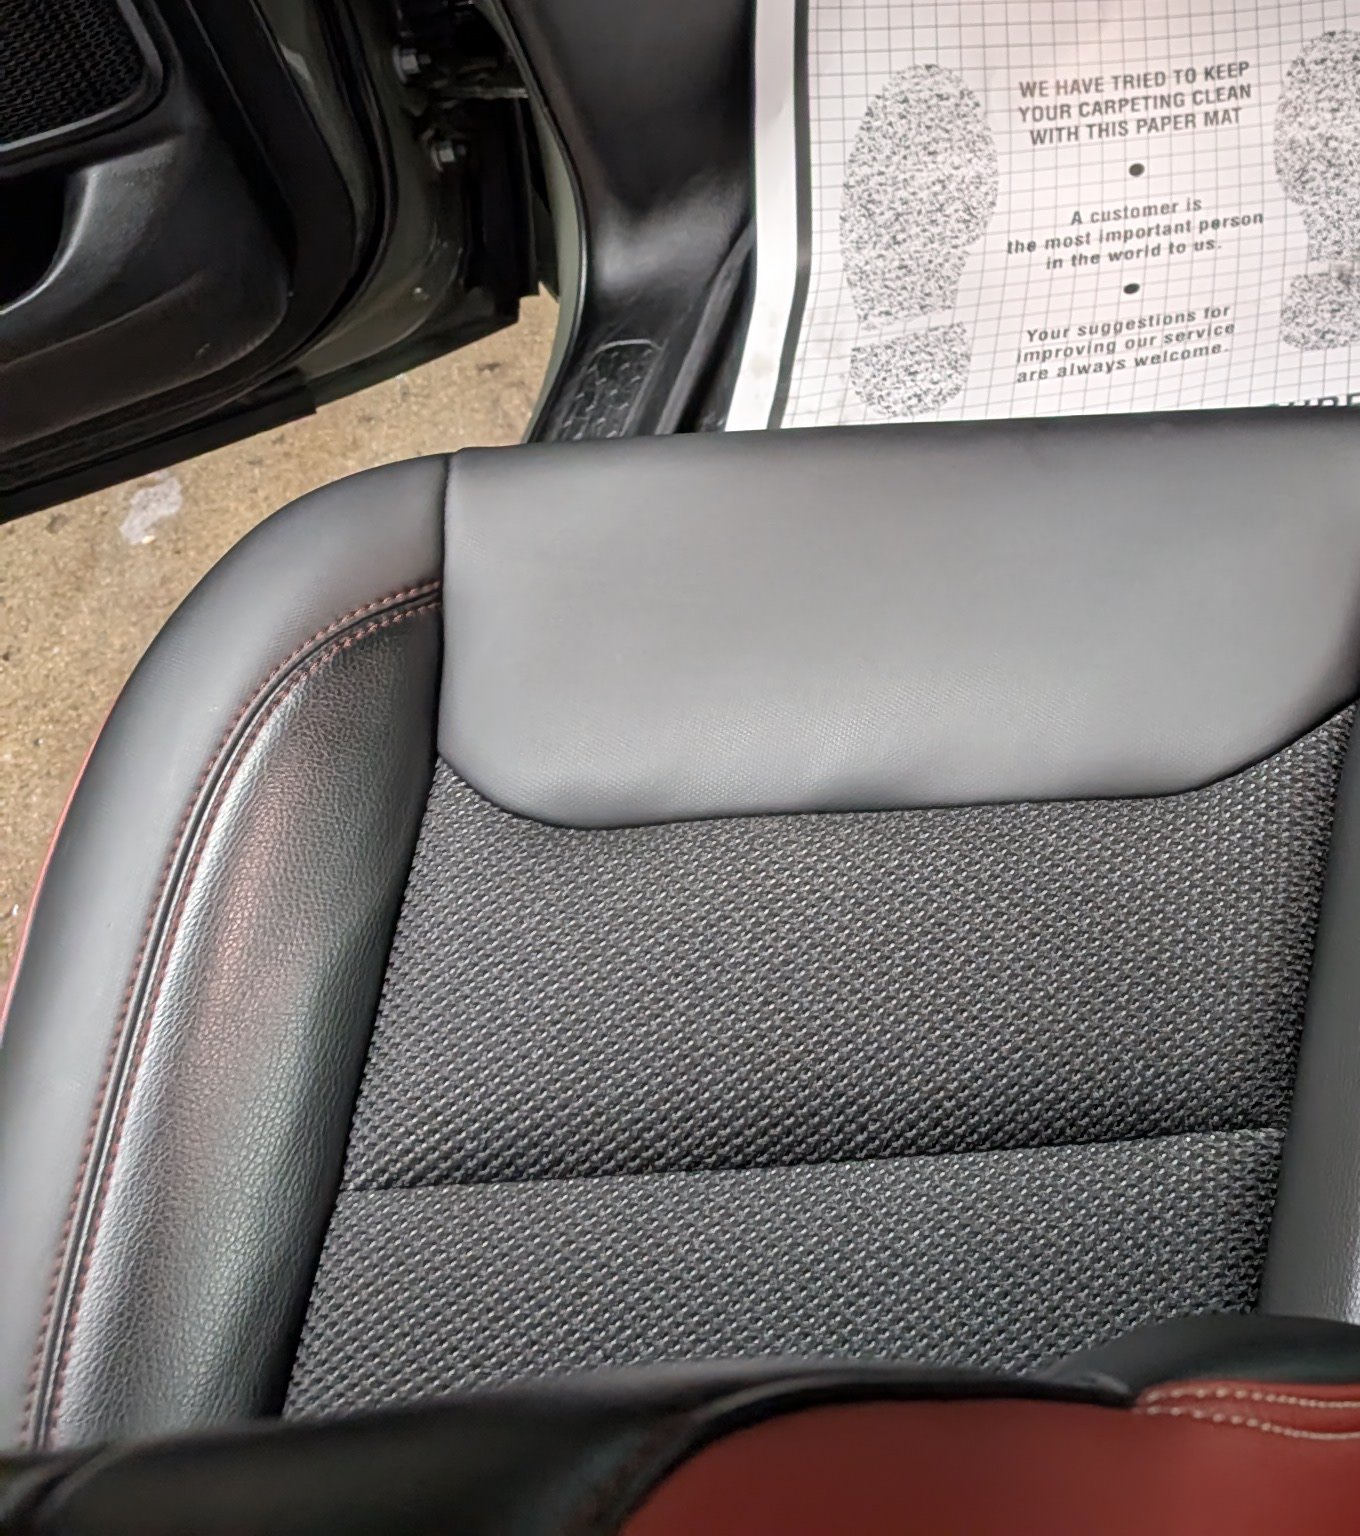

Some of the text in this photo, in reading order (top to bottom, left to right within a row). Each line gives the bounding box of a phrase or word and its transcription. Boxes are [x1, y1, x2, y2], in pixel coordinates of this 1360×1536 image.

[1019, 60, 1250, 99] WE HAVE TRIED TO KEEP
[1018, 82, 1252, 123] YOUR CARPETING CLEAN
[1030, 107, 1243, 146] WITH THIS PAPER MAT
[1070, 197, 1203, 226] A customer is
[1006, 212, 1265, 255] the most important person
[1046, 237, 1223, 270] in the world to us.
[1016, 321, 1236, 364] improving our service
[1026, 305, 1231, 344] Your suggestions for
[1016, 342, 1231, 384] are always welcome.
